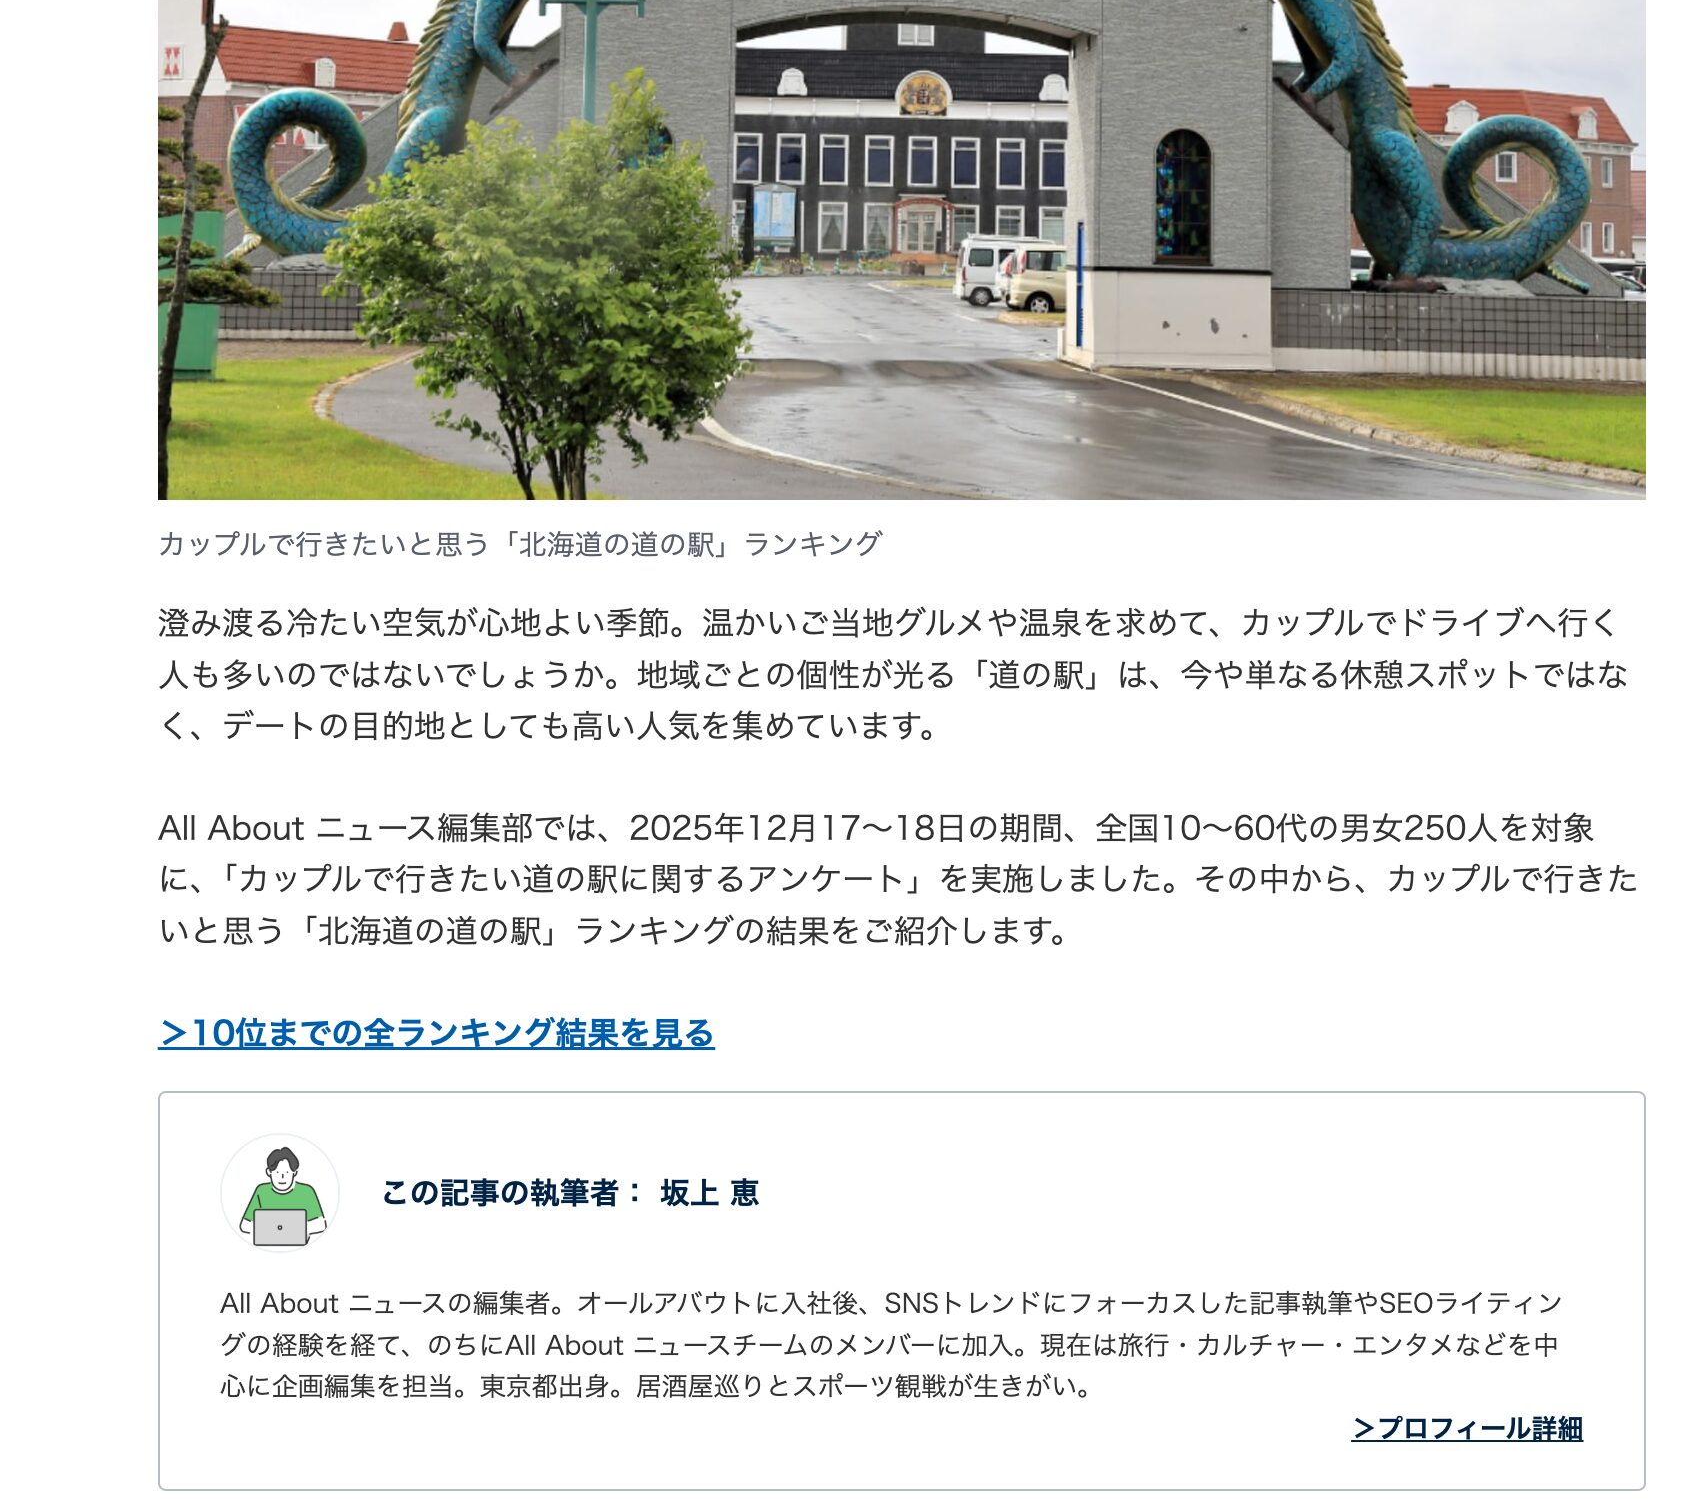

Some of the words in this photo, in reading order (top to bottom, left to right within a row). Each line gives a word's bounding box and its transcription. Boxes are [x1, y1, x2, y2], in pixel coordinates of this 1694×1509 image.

[159, 529, 884, 558] カップルで行きたいと思う「北海道の道の駅」ランキング
[163, 708, 935, 742] く、デートの目的地としても高い人気を集めています。
[157, 811, 196, 844] All
[207, 811, 305, 844] About
[161, 914, 1065, 947] いと思う「北海道の道の駅」ランキングの結果をご紹介します。
[383, 1177, 641, 1208] この記事の執筆者：
[660, 1177, 720, 1208] 坂上
[730, 1177, 760, 1208] 恵
[219, 1290, 251, 1316] All
[259, 1290, 340, 1316] About
[221, 1331, 536, 1358] グの経験を経て、のちにAll
[544, 1331, 625, 1358] About
